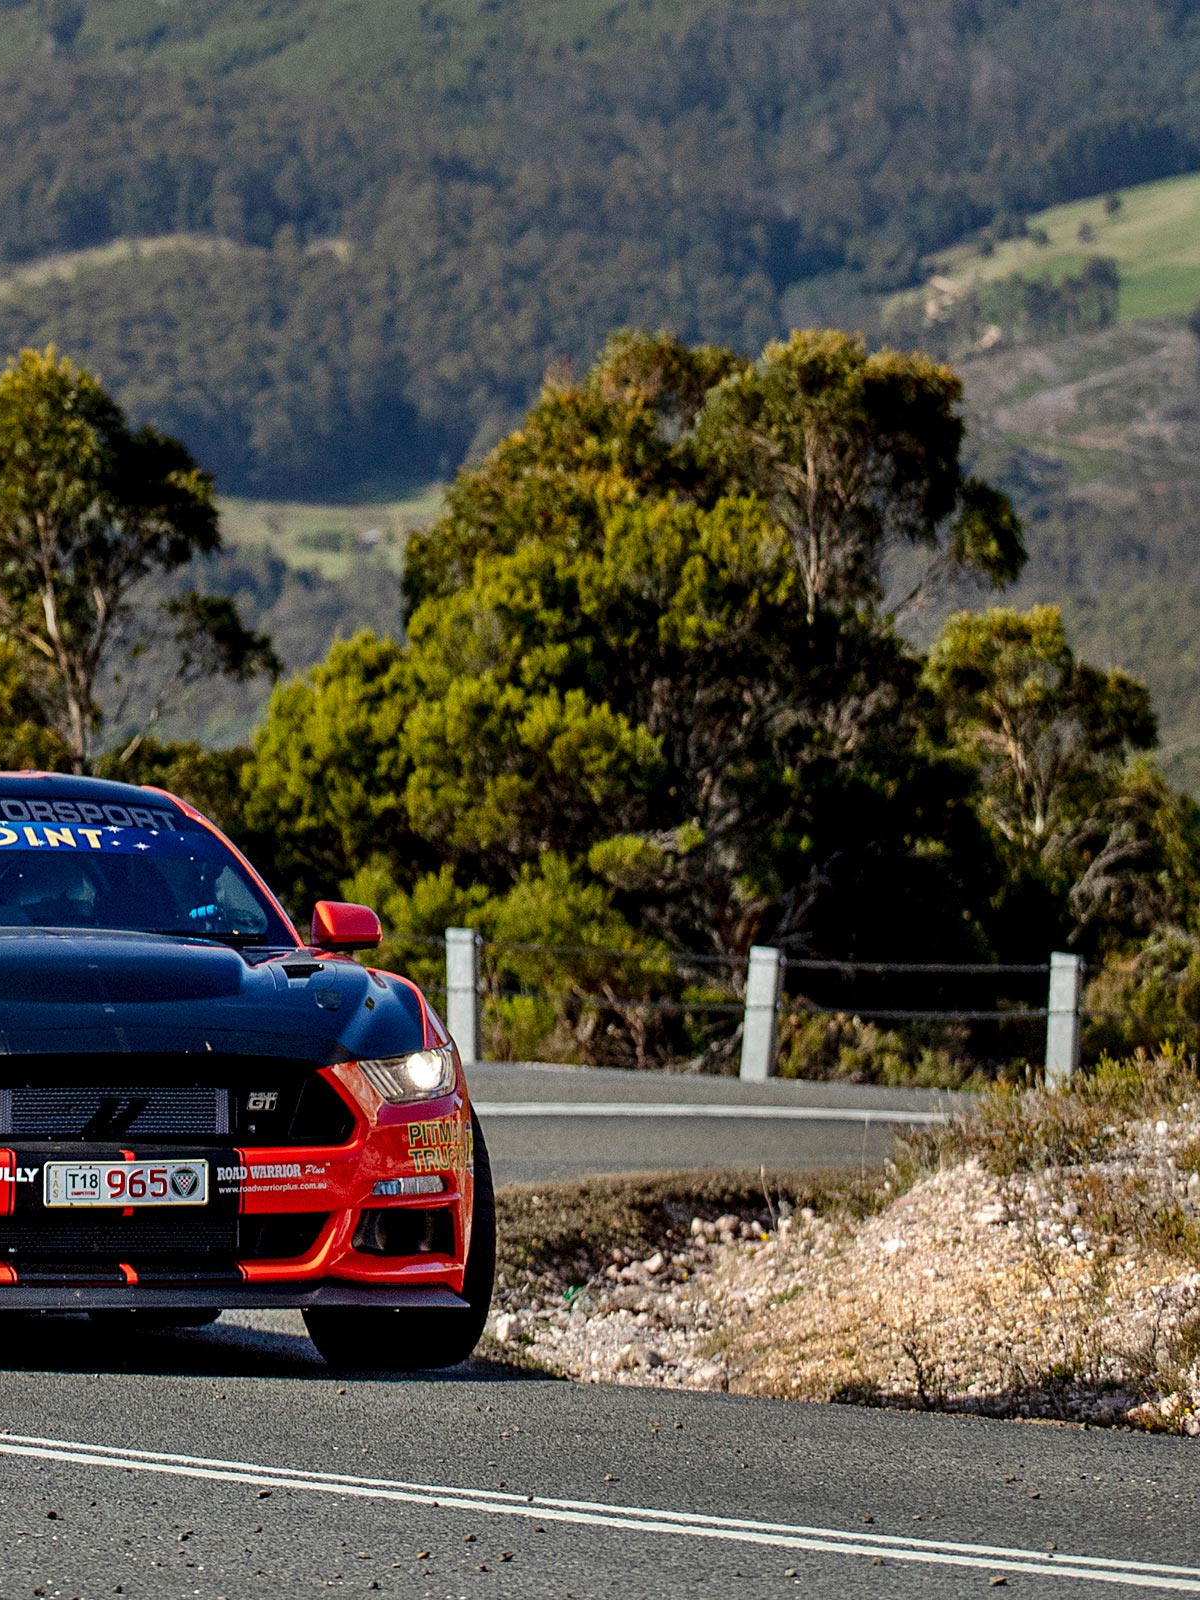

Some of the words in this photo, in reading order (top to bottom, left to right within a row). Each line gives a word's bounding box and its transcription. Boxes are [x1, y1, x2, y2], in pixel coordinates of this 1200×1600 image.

[407, 1120, 460, 1147] PITMA
[217, 1166, 247, 1180] ROAD
[250, 1164, 301, 1179] WARRIOR
[305, 1164, 325, 1174] Plus
[69, 1174, 98, 1189] T18
[106, 1169, 168, 1198] 965
[219, 1182, 327, 1193] www.roadwarriorplus.com.au
